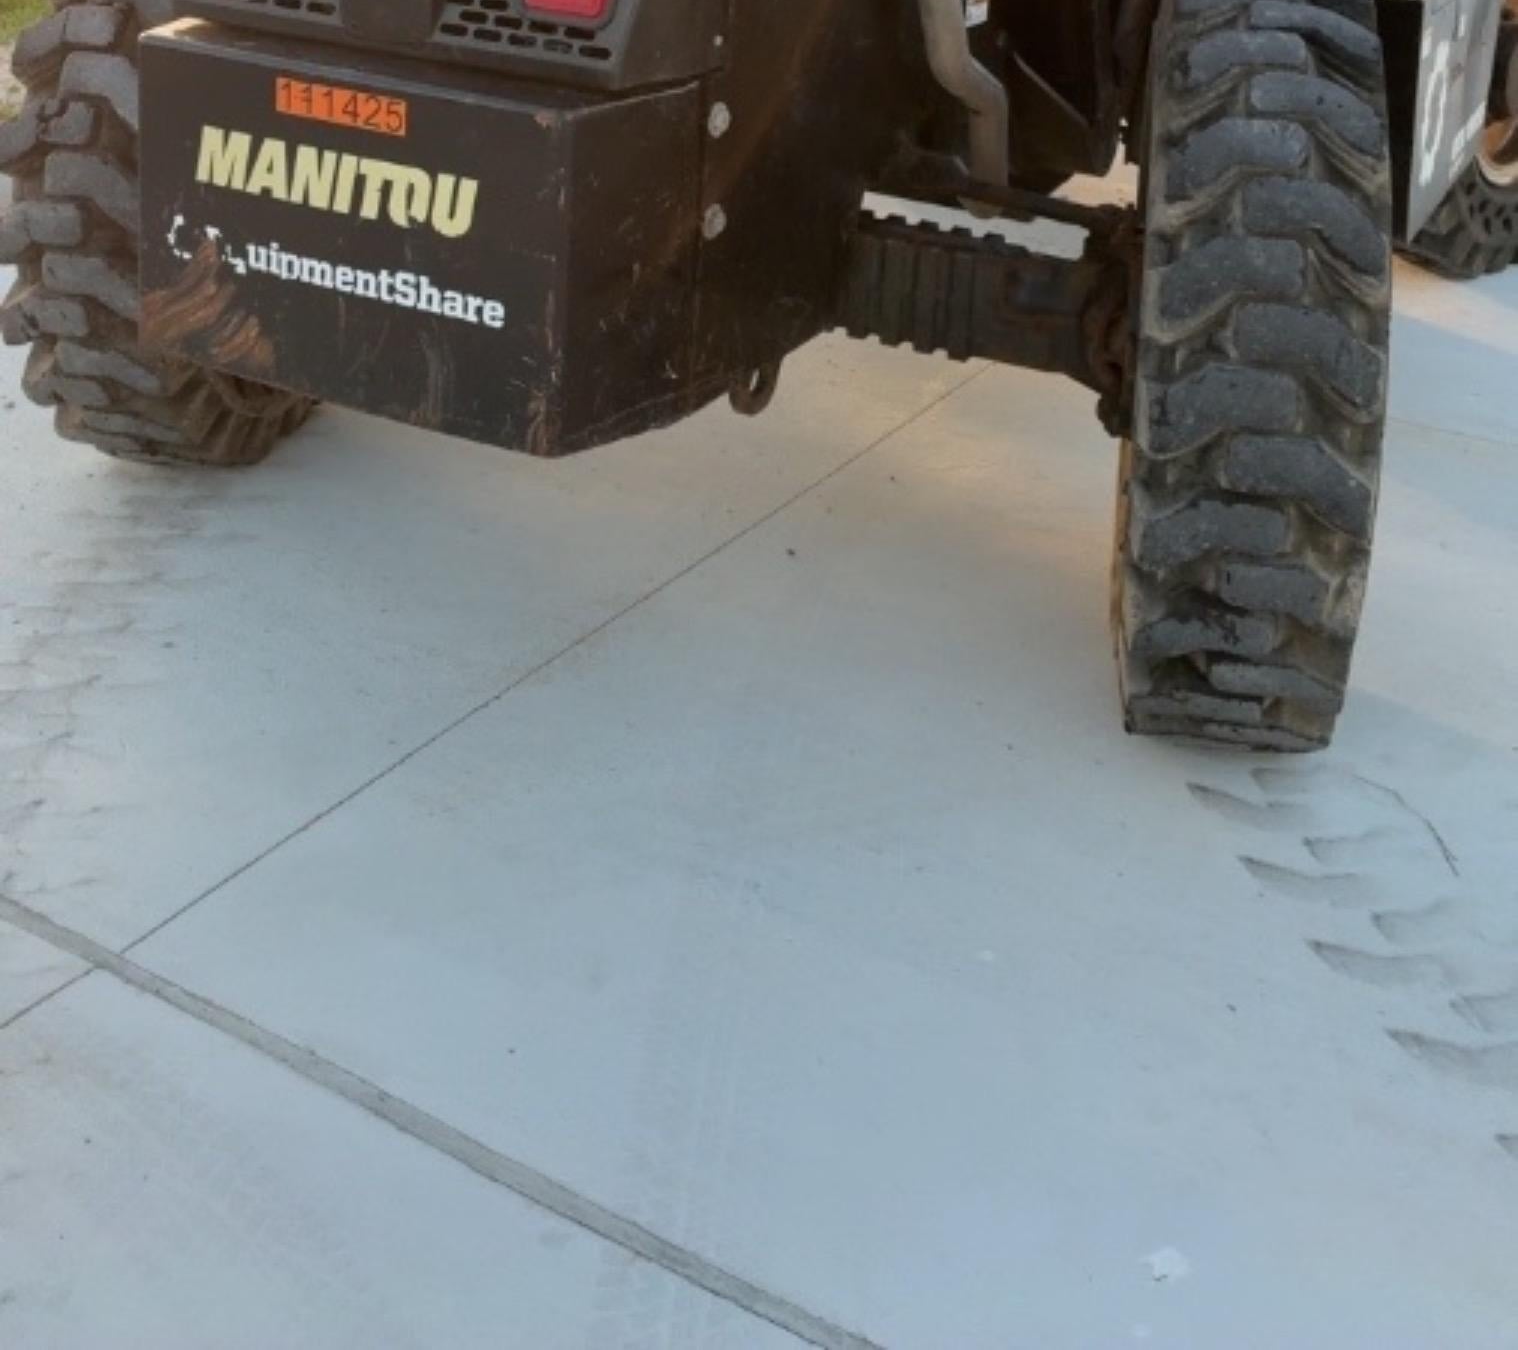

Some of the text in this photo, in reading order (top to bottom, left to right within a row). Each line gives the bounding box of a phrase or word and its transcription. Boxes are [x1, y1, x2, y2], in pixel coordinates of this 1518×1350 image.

[281, 80, 402, 132] 111425
[196, 125, 478, 238] MANITOU
[222, 240, 506, 328] uipmentShare
